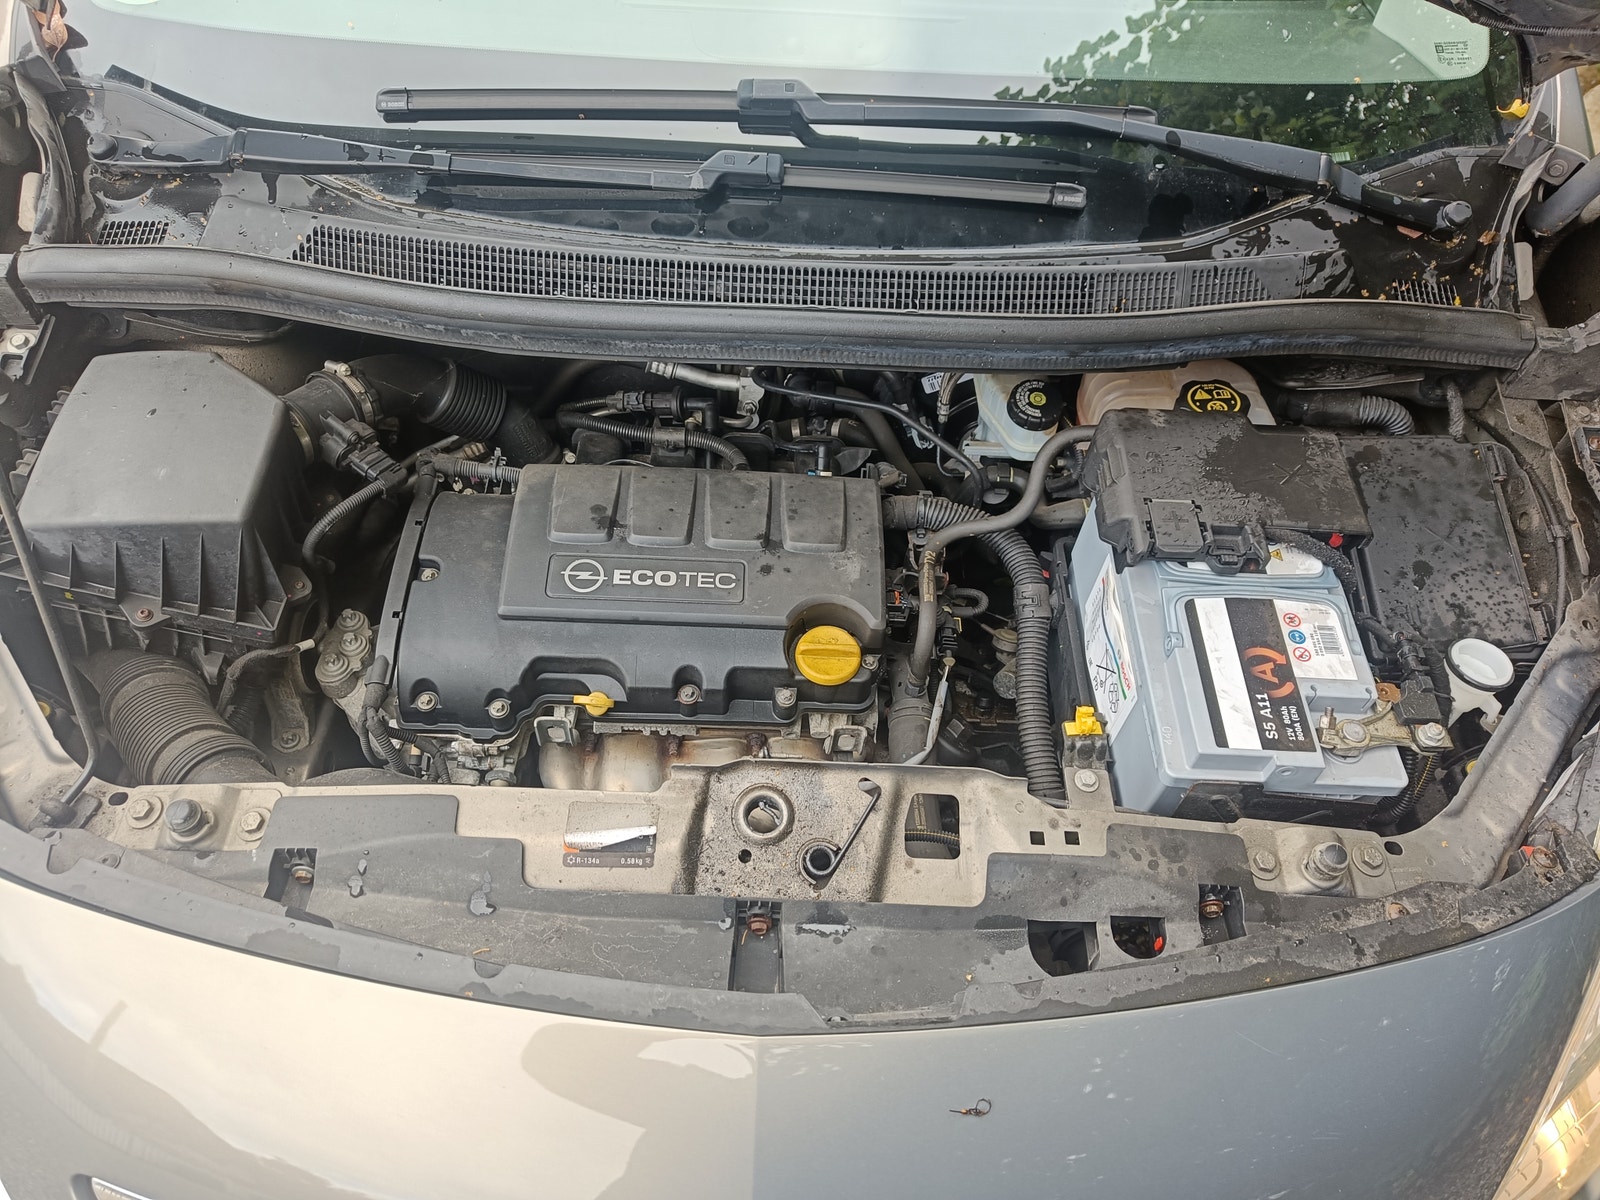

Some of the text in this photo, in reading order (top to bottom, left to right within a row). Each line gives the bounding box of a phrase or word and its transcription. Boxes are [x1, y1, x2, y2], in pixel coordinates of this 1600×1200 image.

[612, 569, 737, 589] ECOTEC
[1255, 693, 1278, 740] S5 A11
[1281, 705, 1296, 741] 12V 80Ah
[1288, 705, 1305, 741] 800A (EN)
[635, 857, 643, 866] kg
